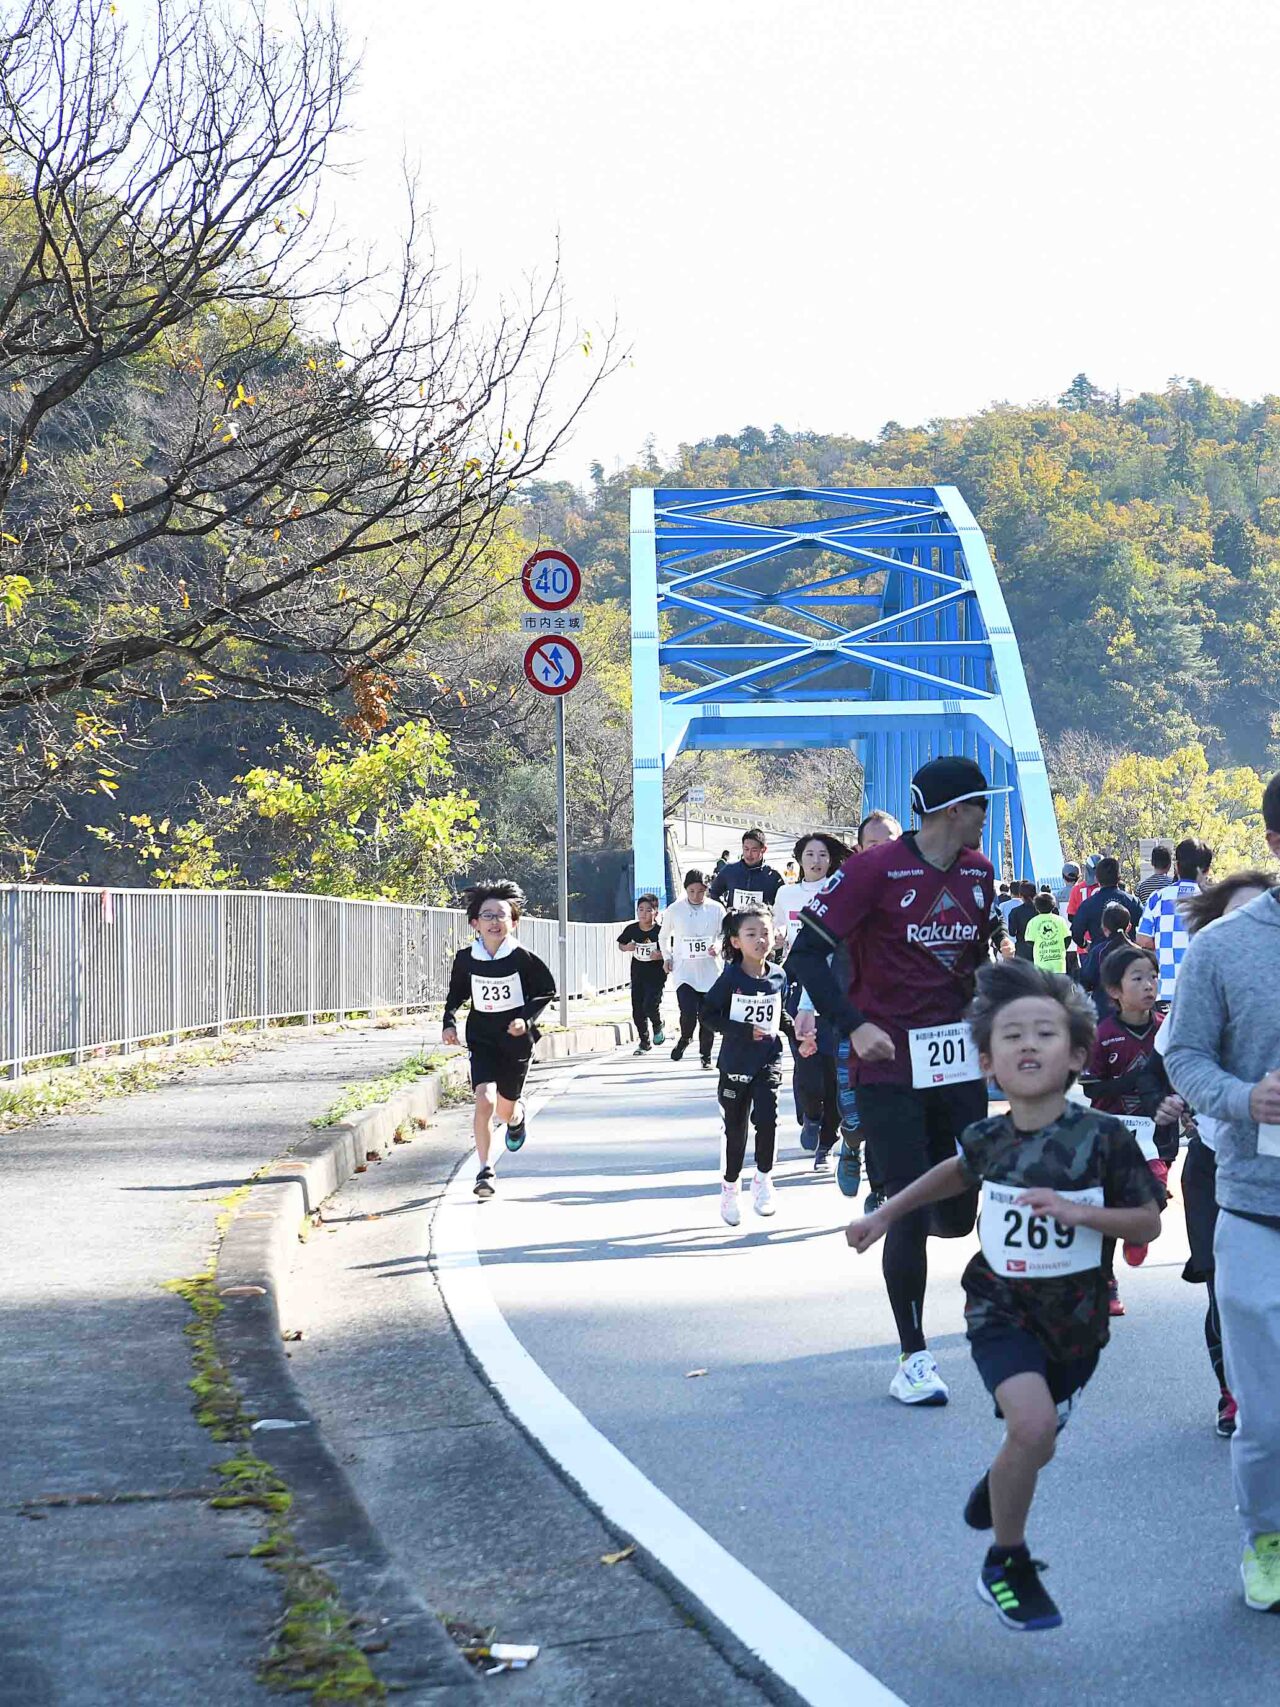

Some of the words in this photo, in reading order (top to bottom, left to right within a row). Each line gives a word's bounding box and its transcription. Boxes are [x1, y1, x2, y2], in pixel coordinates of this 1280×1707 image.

[535, 567, 568, 594] 40
[524, 617, 580, 629] 市内全域
[635, 946, 651, 956] 175
[689, 941, 707, 953] 195
[482, 985, 511, 1001] 233
[744, 1004, 774, 1023] 259
[928, 1037, 966, 1067] 201
[1003, 1209, 1076, 1250] 269
